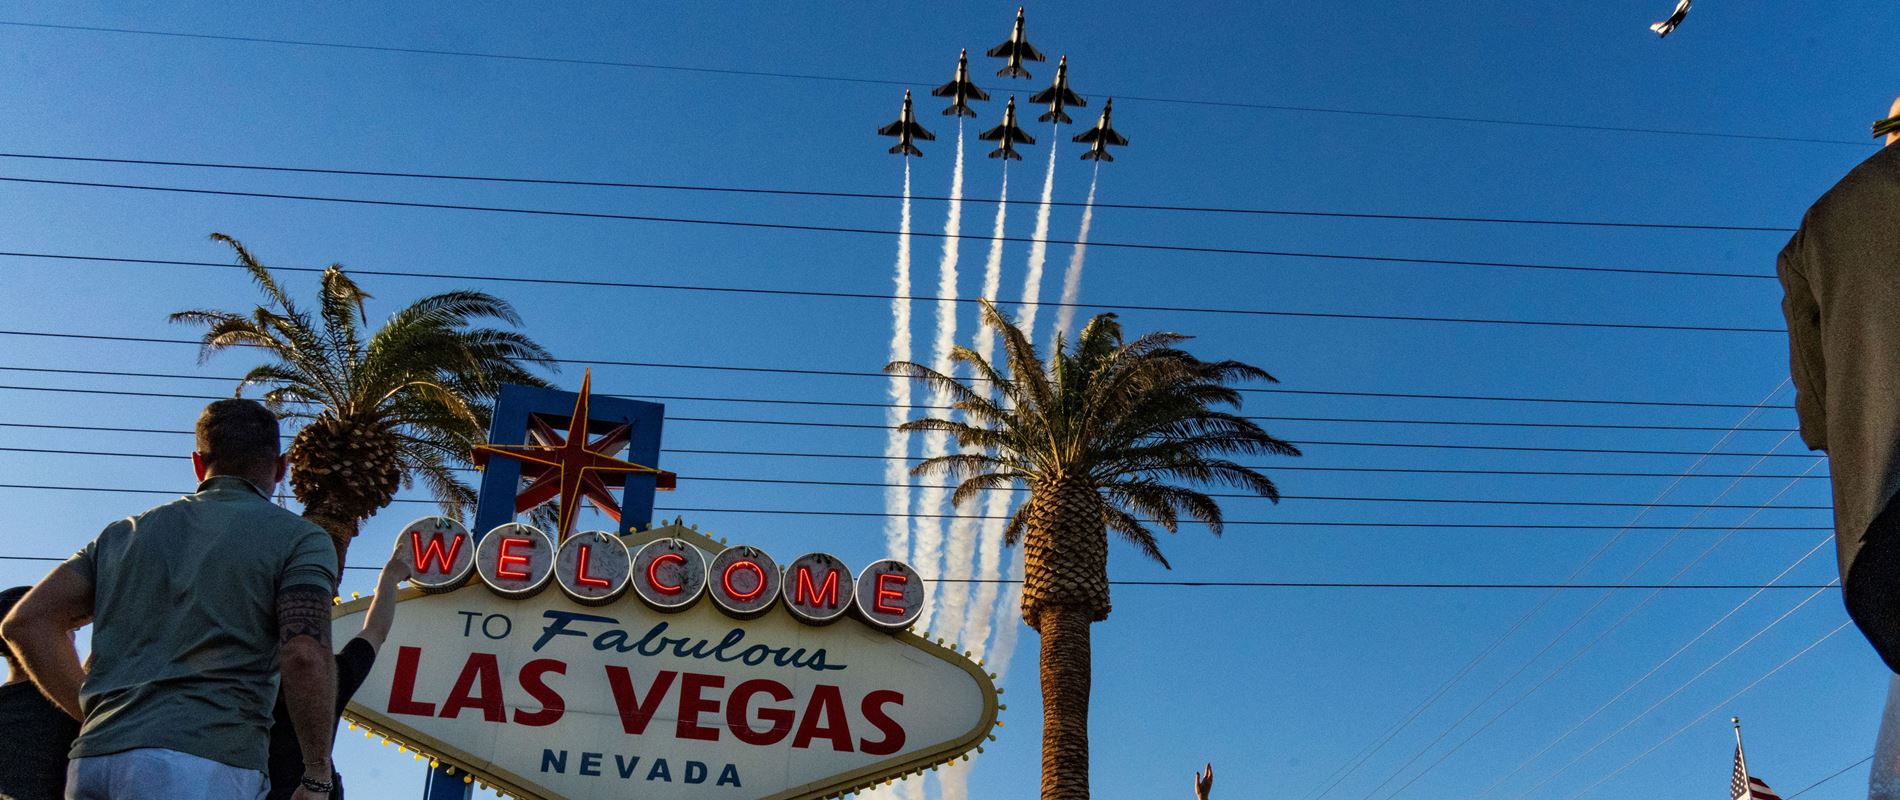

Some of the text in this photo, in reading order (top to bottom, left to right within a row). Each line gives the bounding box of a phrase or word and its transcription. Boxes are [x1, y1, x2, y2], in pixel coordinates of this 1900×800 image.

[410, 529, 908, 614] WELCOME
[458, 608, 848, 671] TO Fabulous
[386, 645, 906, 756] LAS VEGAS
[540, 748, 742, 788] NEVADA
